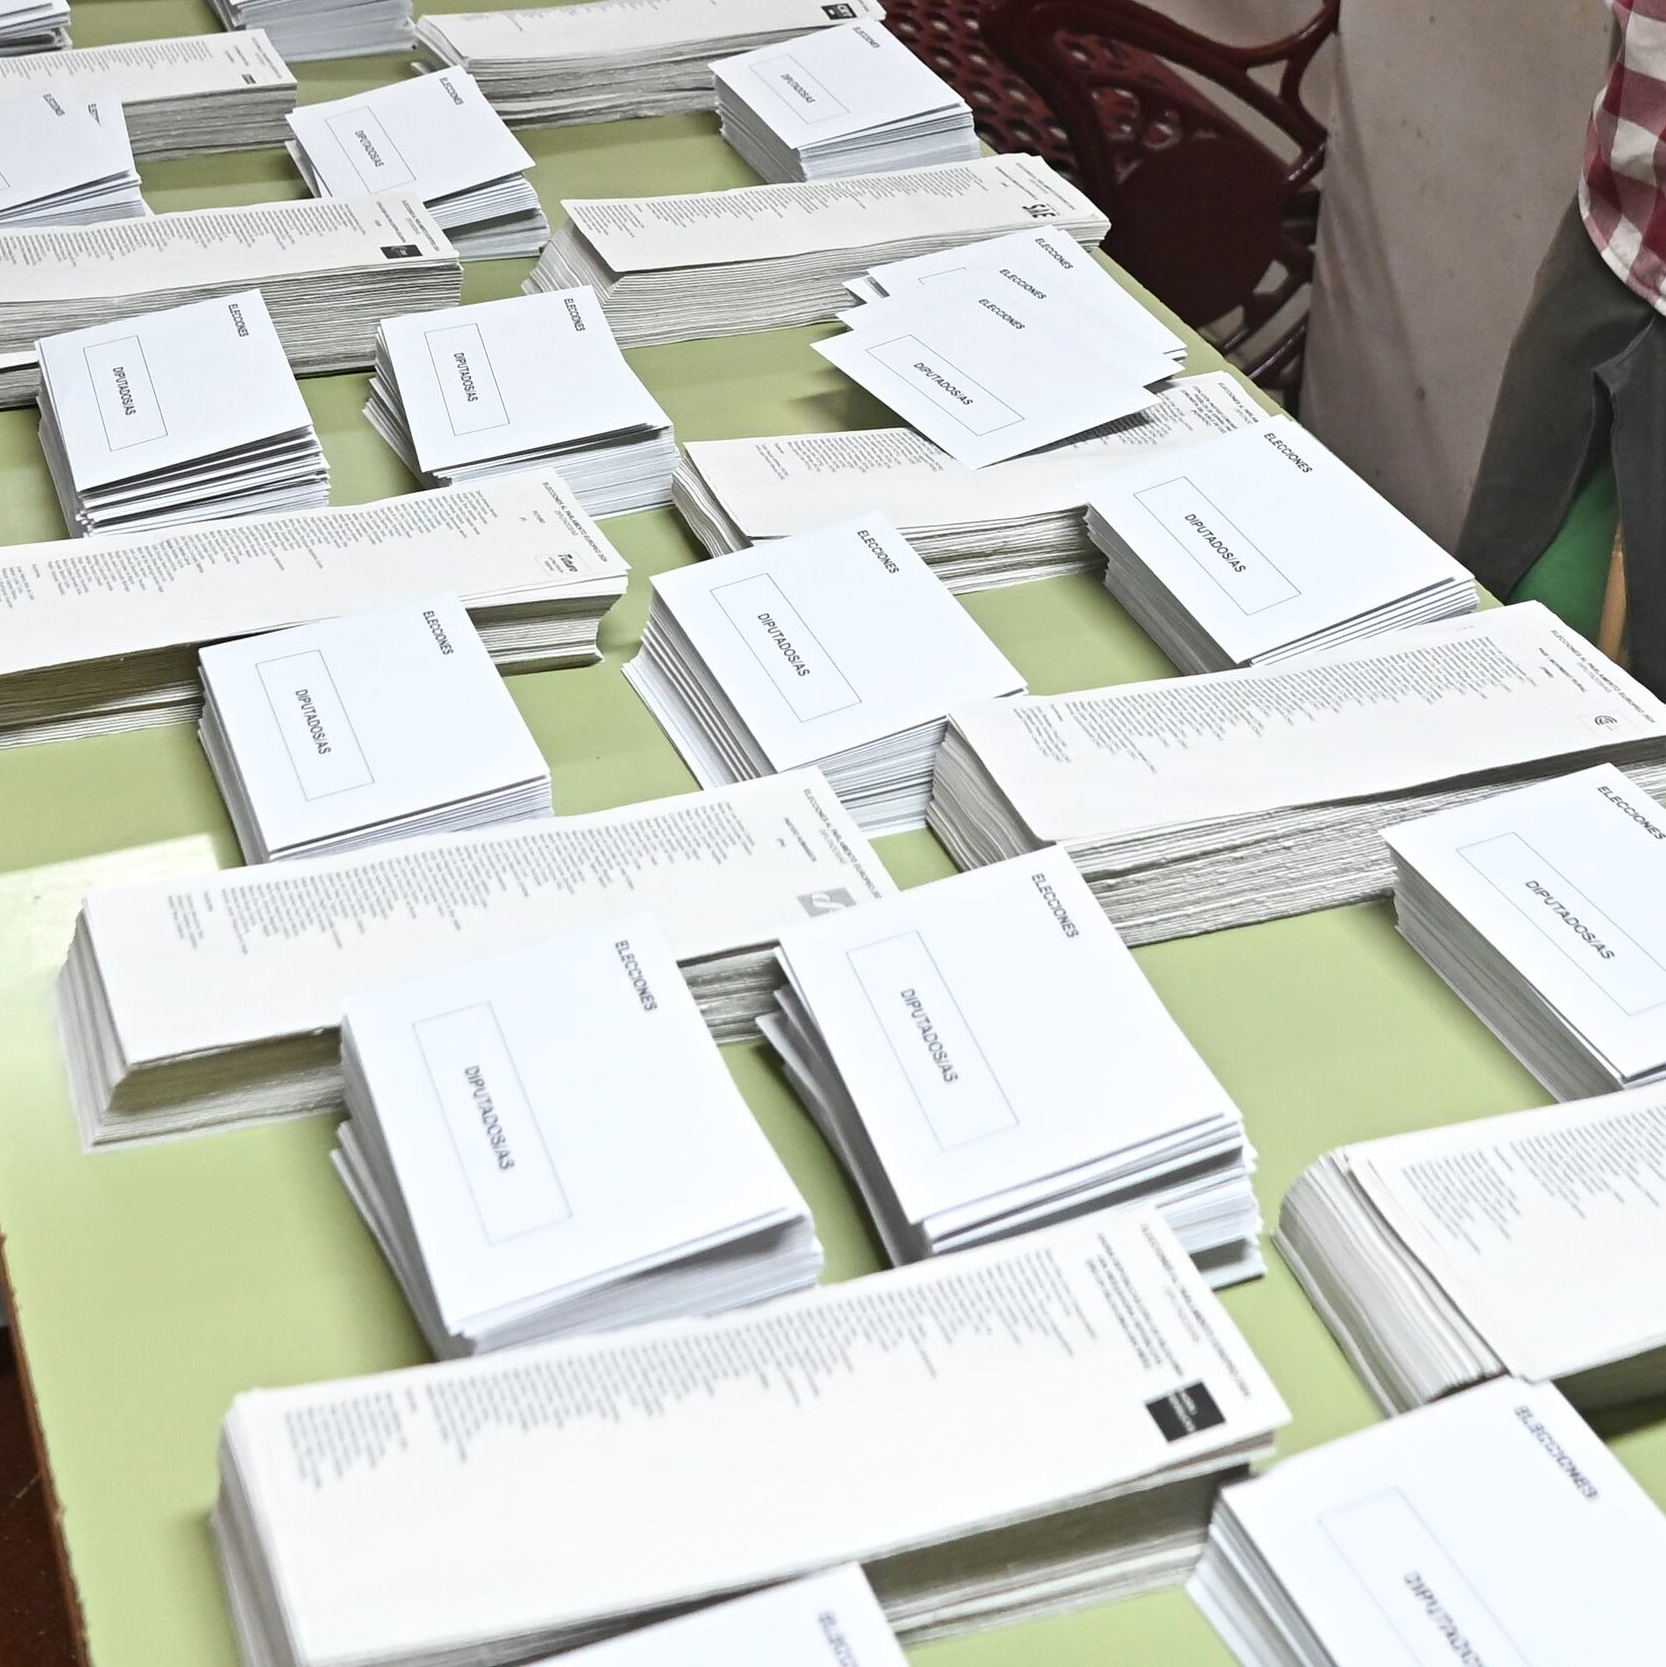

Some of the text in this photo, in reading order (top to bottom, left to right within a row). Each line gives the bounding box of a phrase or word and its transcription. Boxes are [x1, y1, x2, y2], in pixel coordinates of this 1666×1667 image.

[1035, 237, 1074, 270] ELECCIONES
[999, 269, 1046, 299] ELECCIONES
[228, 304, 249, 337] ELECCIONES
[564, 298, 585, 331] ELECCIONES
[979, 299, 1025, 329] ELECCIONES
[113, 367, 136, 415] DIPUTADOS/AS
[454, 353, 478, 402] DIPUTADOS/AS
[914, 361, 974, 406] DIPUTADOS/AS
[1264, 431, 1314, 474] ELECCIONES
[857, 528, 902, 573] ELECCIONES
[1185, 514, 1246, 572] DIPUTADOS/AS
[423, 611, 453, 655] ELECCIONES
[758, 613, 810, 676] DIPUTADOS/AS
[295, 689, 331, 754] DIPUTADOS/AS
[1597, 785, 1666, 841] ELECCIONES
[1032, 874, 1080, 938] ELECCIONES
[1525, 880, 1615, 959] DIPUTADOS/AS
[615, 940, 657, 1011] ELECCIONES
[901, 989, 958, 1082] DIPUTADOS/AS
[465, 1066, 515, 1170] DIPUTADOS/AS
[1515, 1404, 1600, 1501] ELECCIONES
